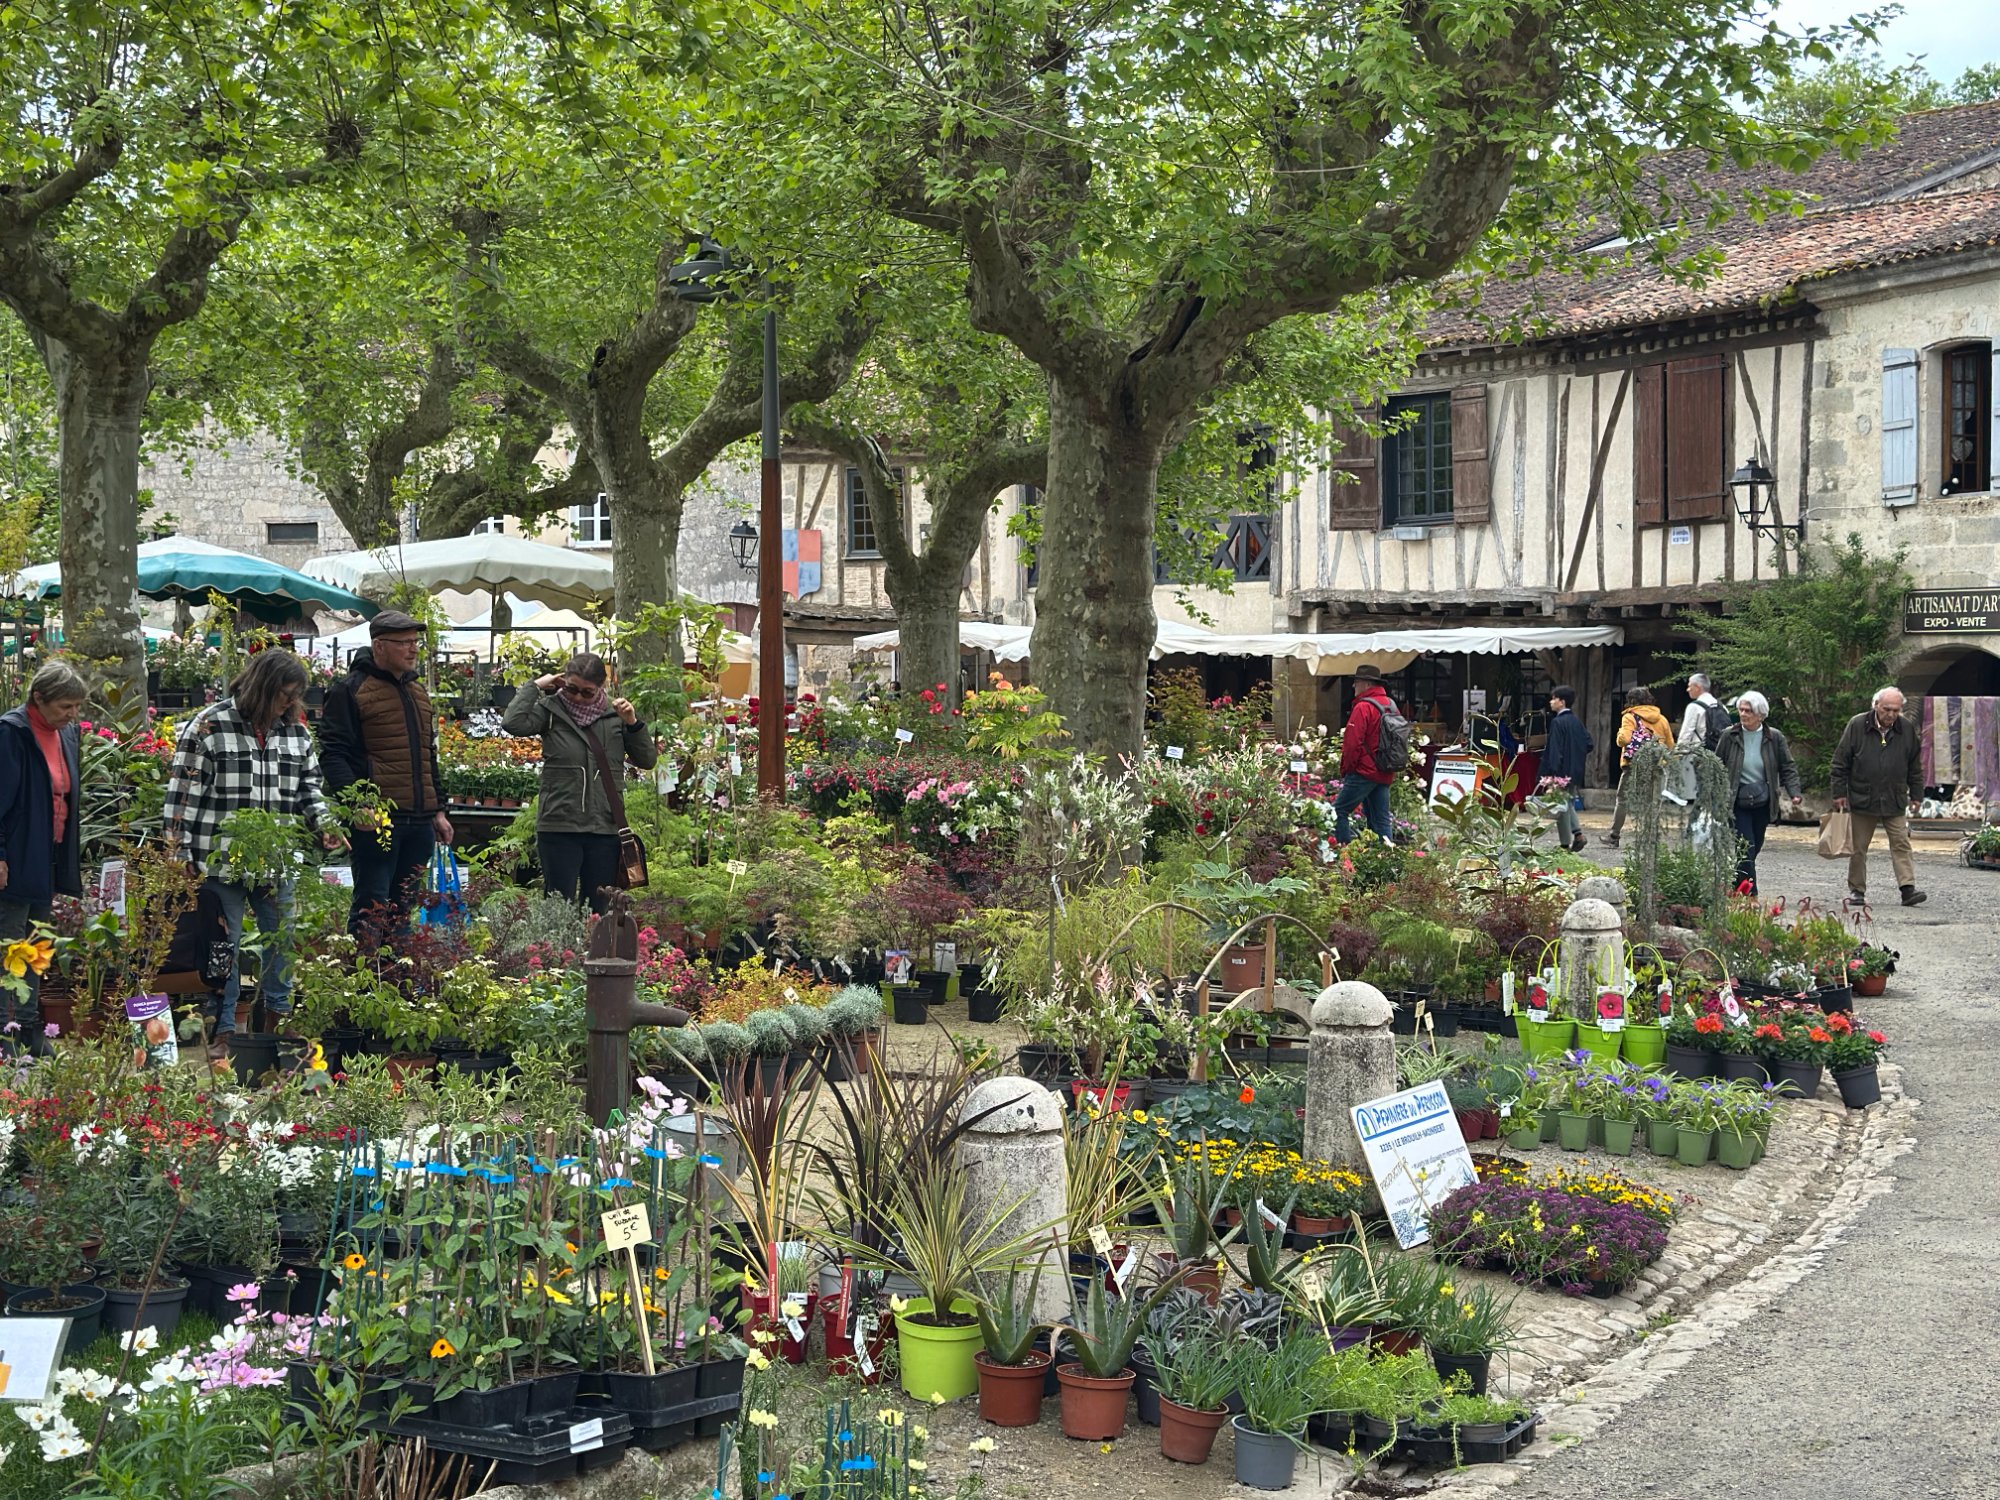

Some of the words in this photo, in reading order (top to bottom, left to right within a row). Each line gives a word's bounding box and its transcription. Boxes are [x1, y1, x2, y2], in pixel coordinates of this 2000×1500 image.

[1907, 596, 1970, 614] ARTISANAT
[1924, 617, 1949, 628] EXPO
[1956, 616, 1987, 627] VENTE
[1394, 1138, 1402, 1148] LE
